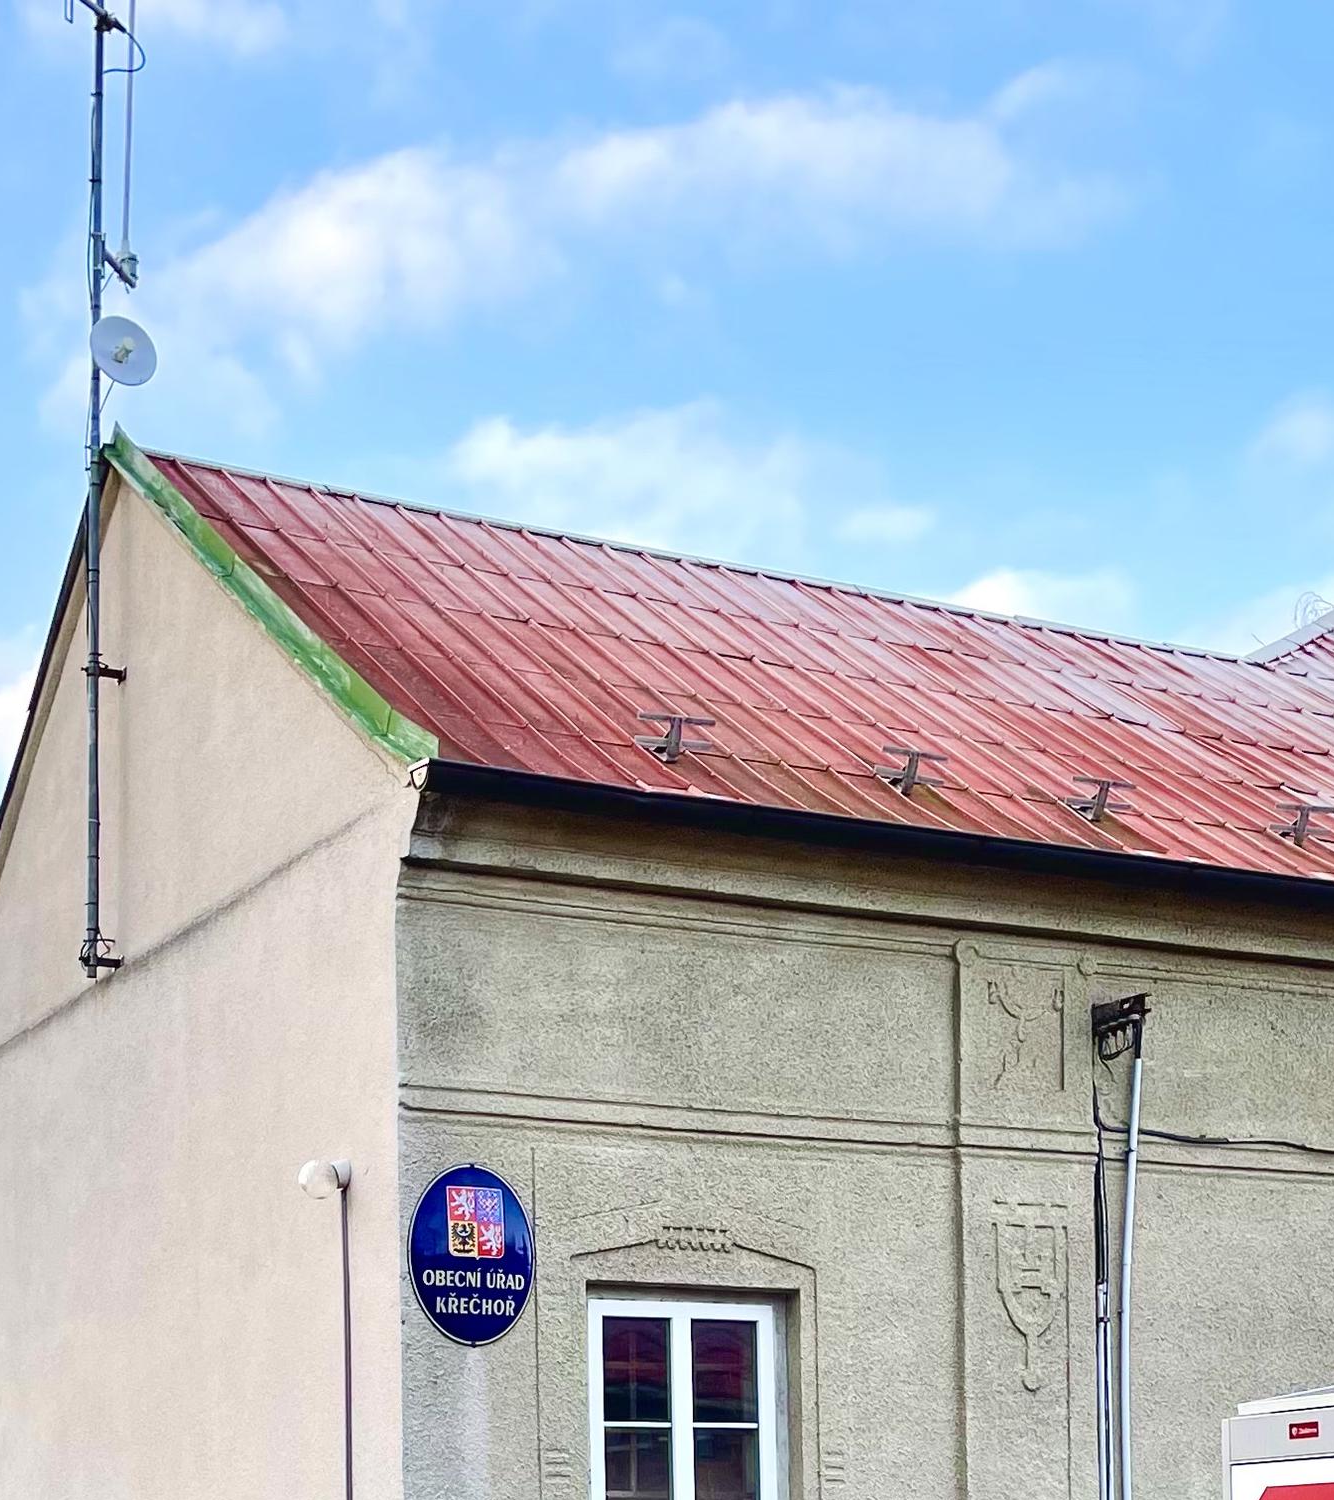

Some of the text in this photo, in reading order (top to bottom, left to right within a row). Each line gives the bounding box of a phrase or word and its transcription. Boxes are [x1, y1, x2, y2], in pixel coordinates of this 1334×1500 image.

[422, 1267, 525, 1290] OBECNÍ ÚŘAD
[435, 1292, 516, 1316] KŘEČHOŘ
